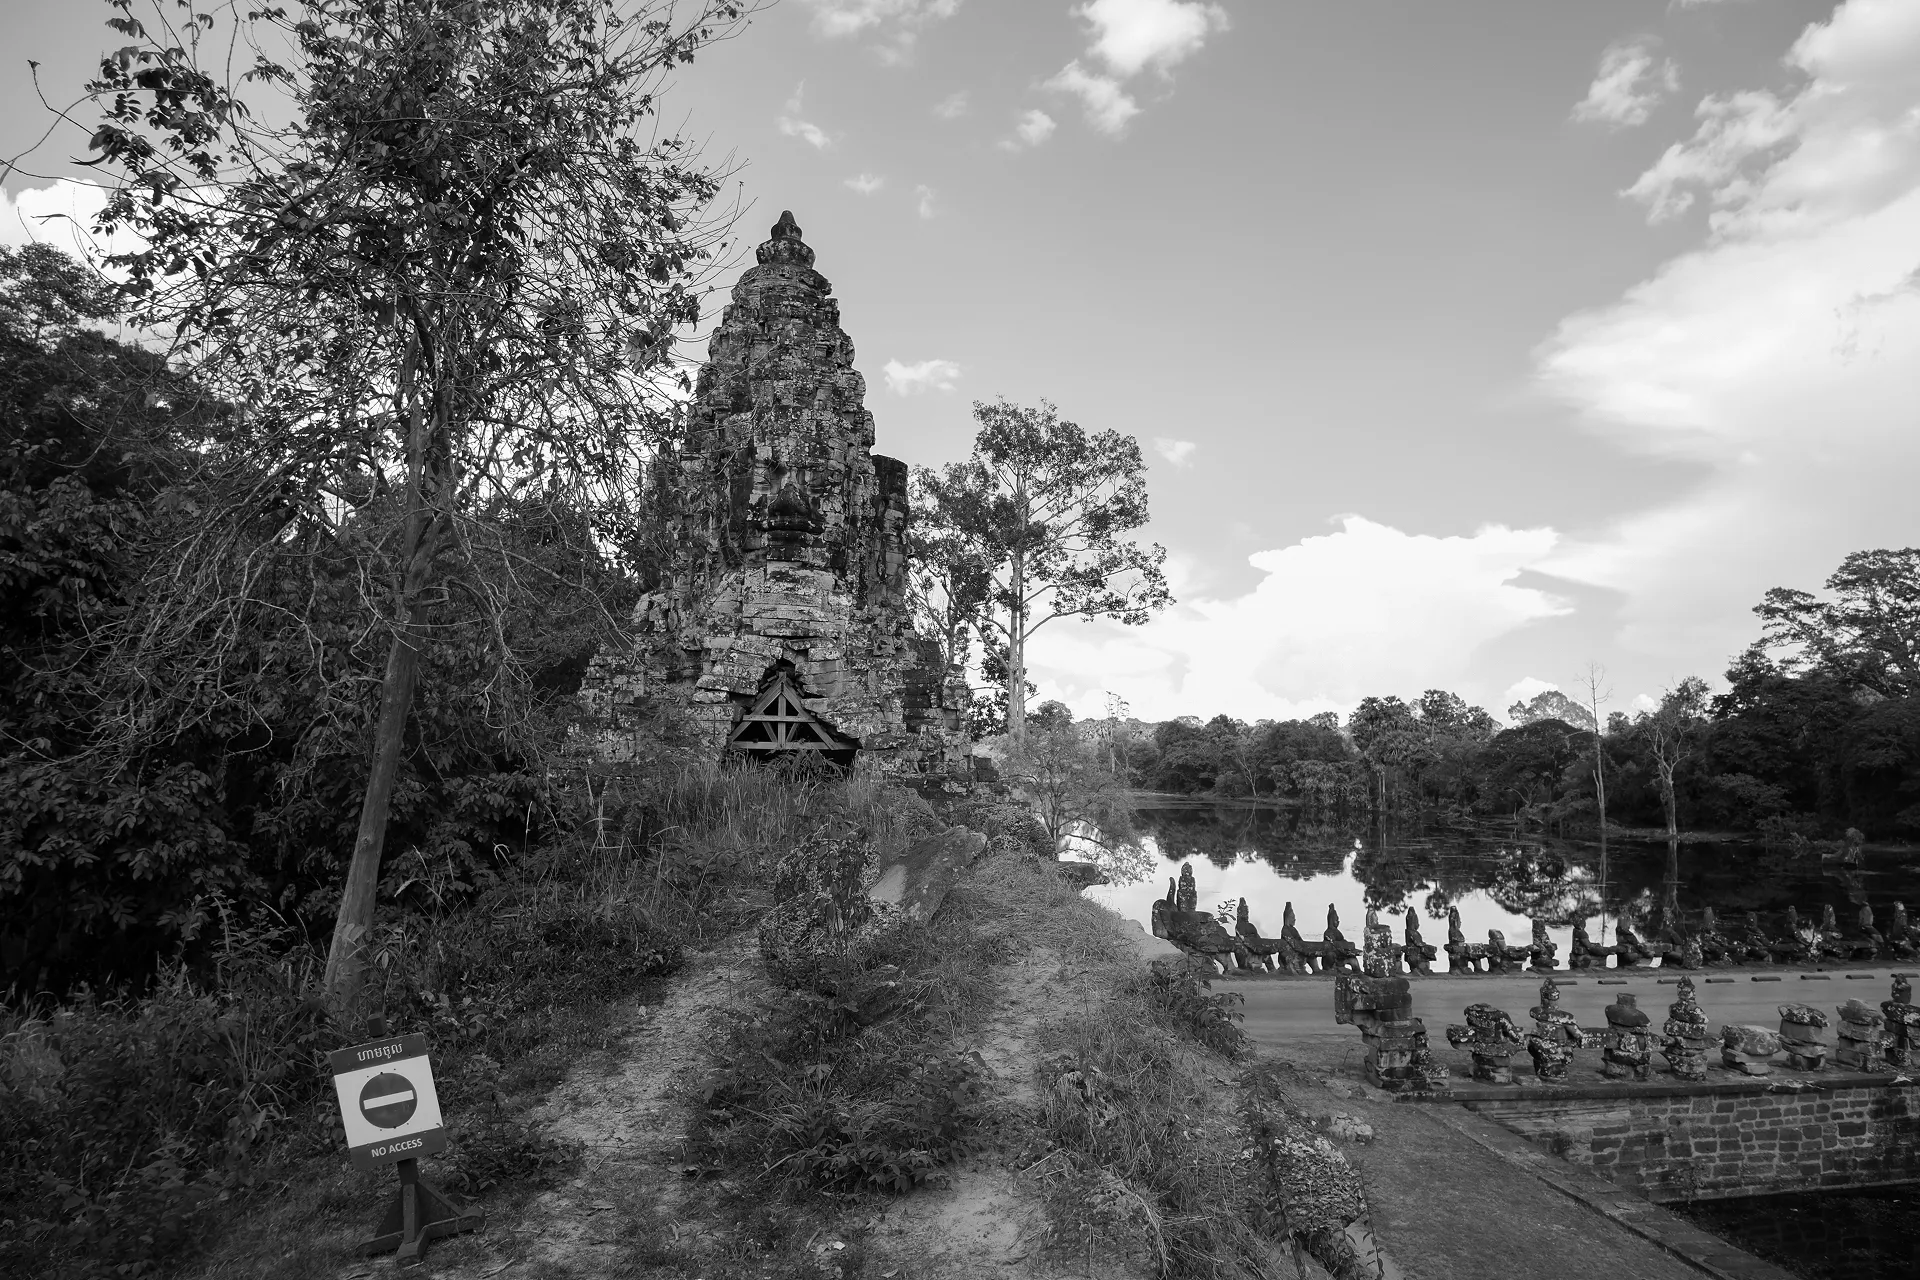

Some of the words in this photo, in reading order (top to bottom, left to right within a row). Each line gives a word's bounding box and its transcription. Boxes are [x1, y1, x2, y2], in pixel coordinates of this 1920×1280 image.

[357, 1043, 403, 1061] ហាមចូល
[371, 1146, 387, 1158] NO
[389, 1138, 423, 1154] ACCESS
